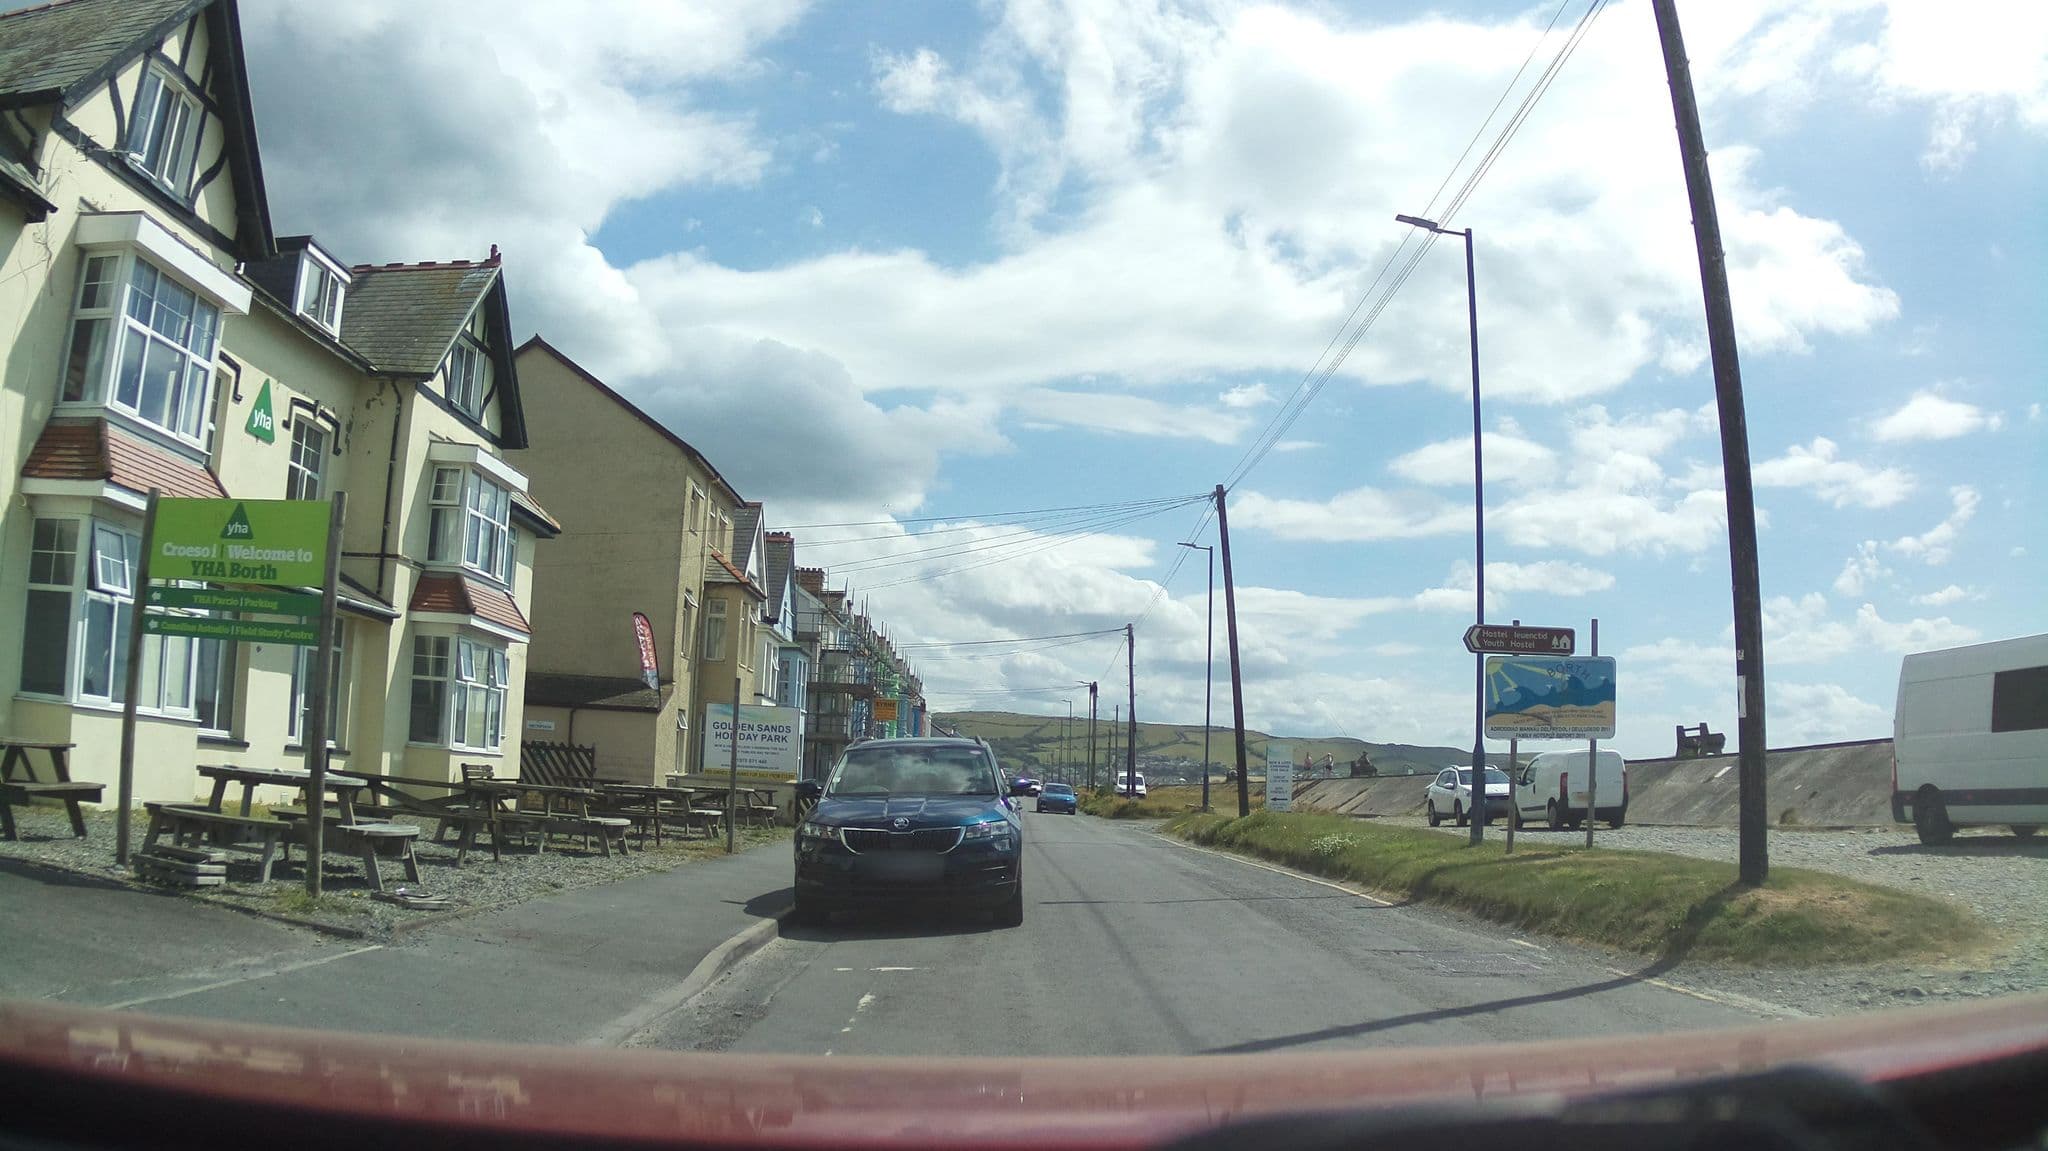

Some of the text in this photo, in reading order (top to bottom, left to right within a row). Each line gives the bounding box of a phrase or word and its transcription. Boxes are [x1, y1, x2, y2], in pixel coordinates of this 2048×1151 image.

[252, 408, 273, 431] yha
[227, 521, 249, 536] yha
[162, 541, 210, 558] Croeso
[227, 544, 294, 562] Welcome
[297, 546, 313, 563] to
[191, 560, 277, 581] YHA Borth
[244, 596, 278, 610] Parking
[259, 626, 283, 640] Study
[1482, 629, 1508, 639] Hostel
[1483, 639, 1535, 648] Youth Hostel
[1547, 660, 1590, 680] BORTH
[757, 723, 792, 734] SANDS
[714, 731, 788, 744] HOLDAY PARK
